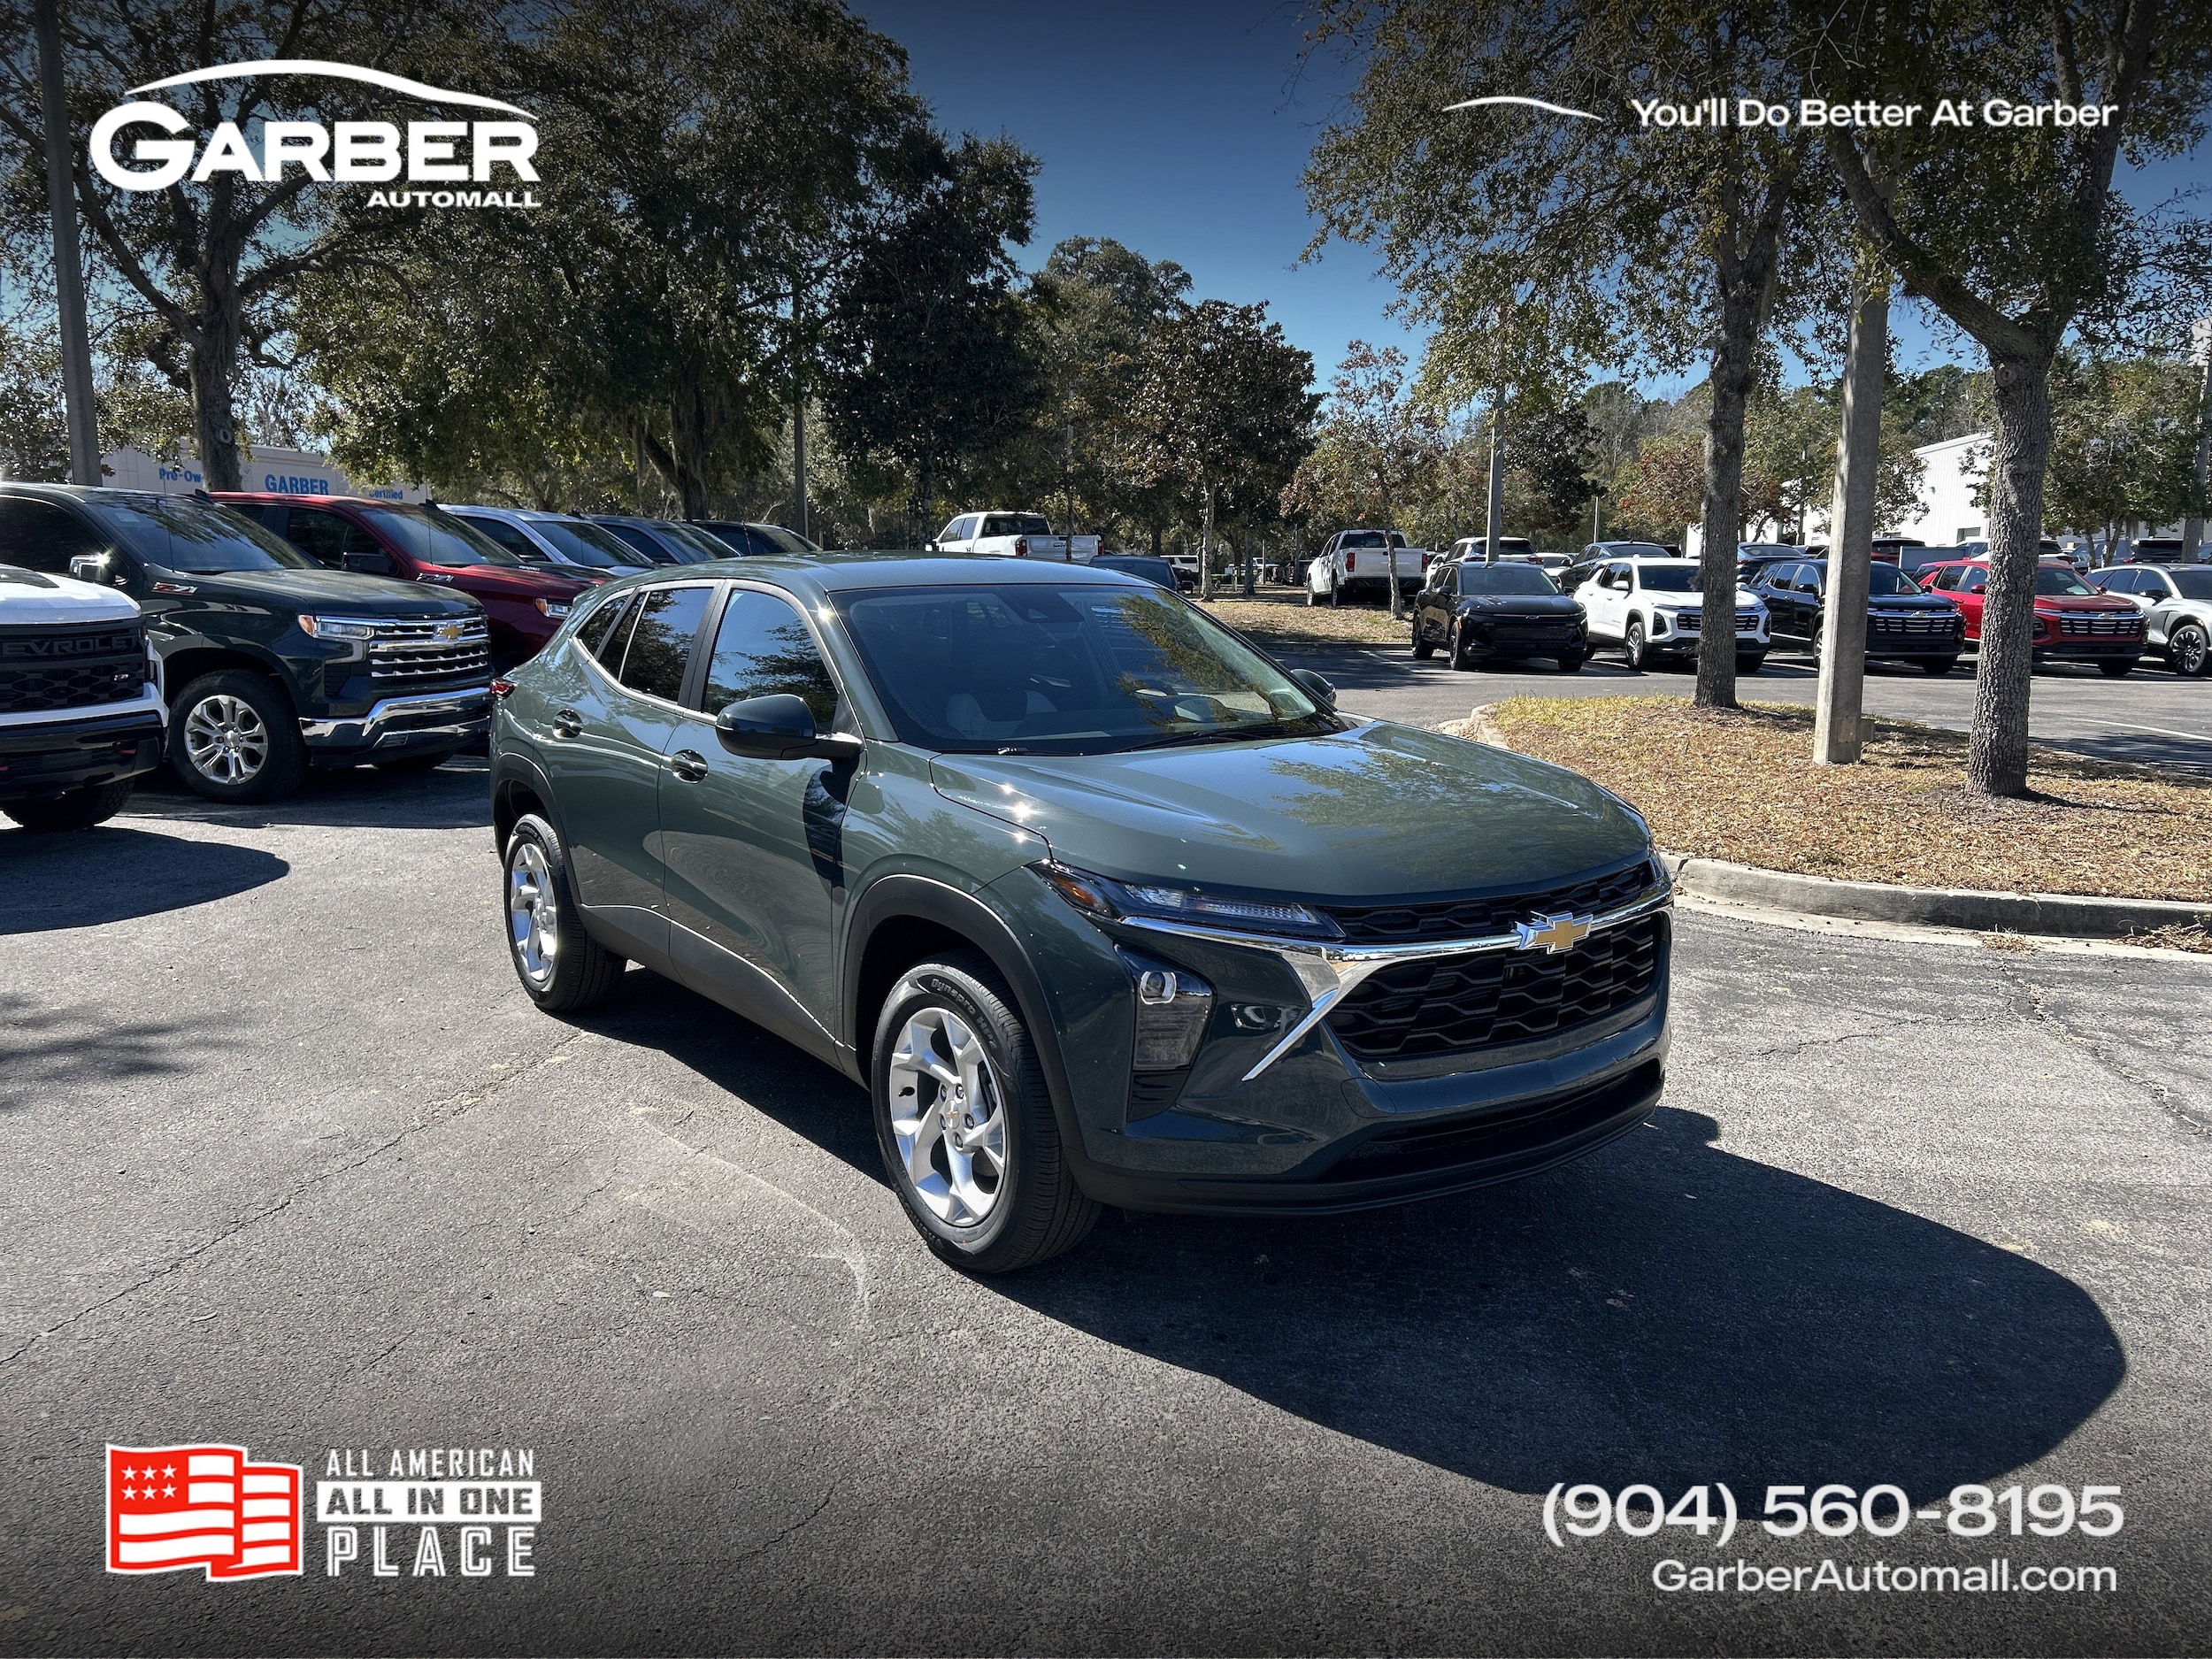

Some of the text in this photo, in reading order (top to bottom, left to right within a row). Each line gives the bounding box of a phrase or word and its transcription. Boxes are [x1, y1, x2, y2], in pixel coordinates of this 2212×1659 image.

[159, 468, 202, 482] Pre-Ow
[265, 474, 328, 495] GARBER
[1, 635, 140, 656] EVROLET
[930, 978, 976, 1015] Dynapro
